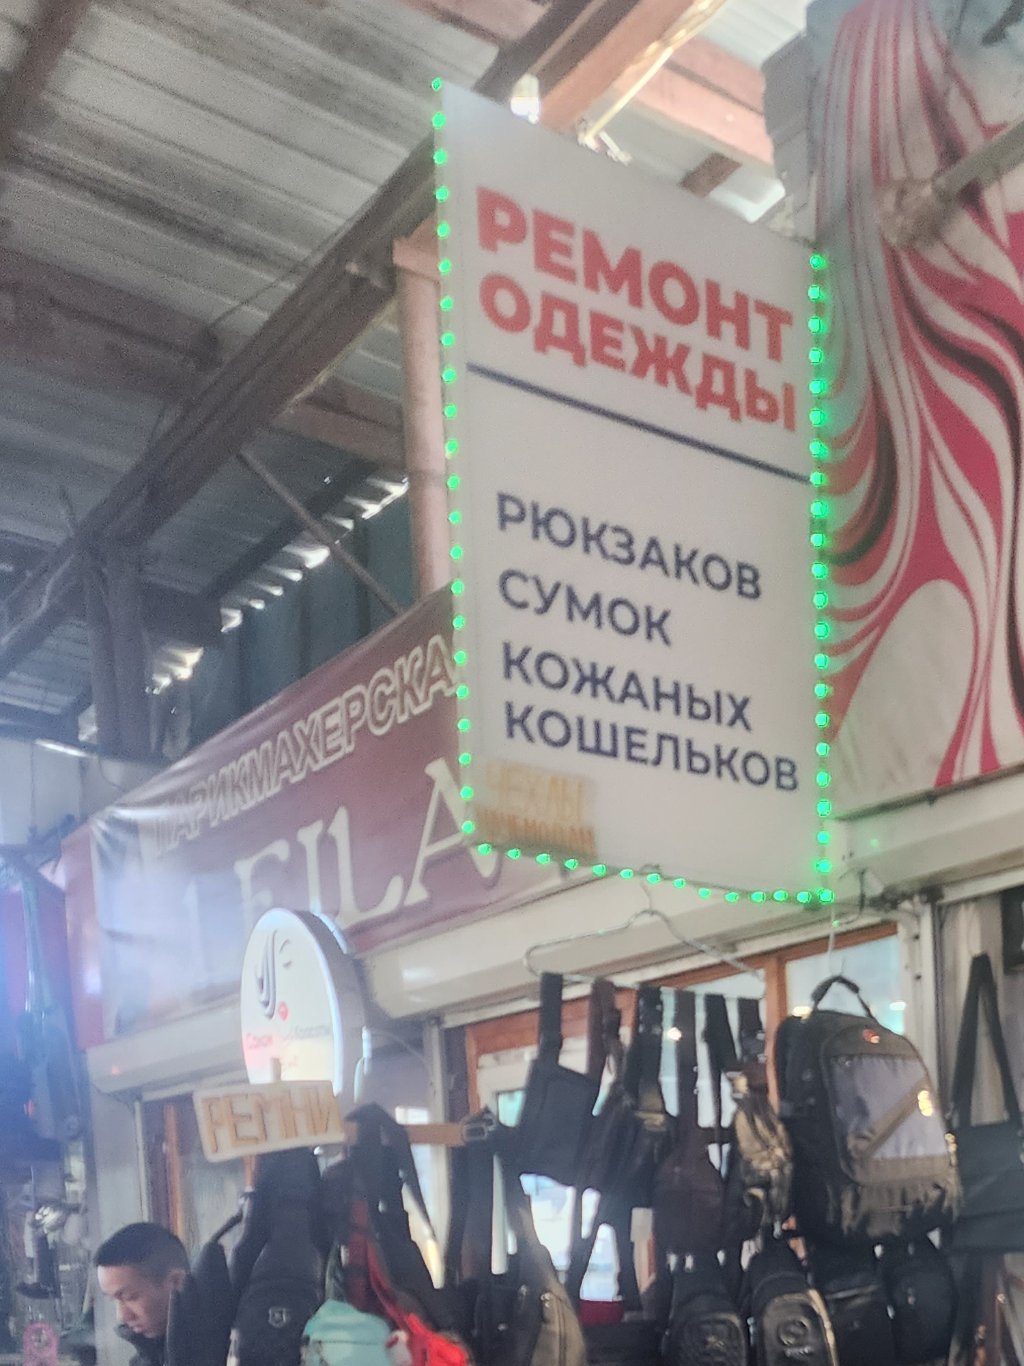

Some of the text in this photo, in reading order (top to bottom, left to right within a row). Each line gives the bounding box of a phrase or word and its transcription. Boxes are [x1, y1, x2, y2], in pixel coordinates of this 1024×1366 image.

[475, 185, 793, 363] РЕМОНТ
[479, 272, 796, 431] ОДЕЖДЫ
[496, 492, 762, 600] РЮКЗАКОВ
[499, 569, 671, 646] СУМОК
[502, 641, 753, 731] КОЖАНЫХ
[505, 700, 799, 793] КОШЕЛЬКОВ
